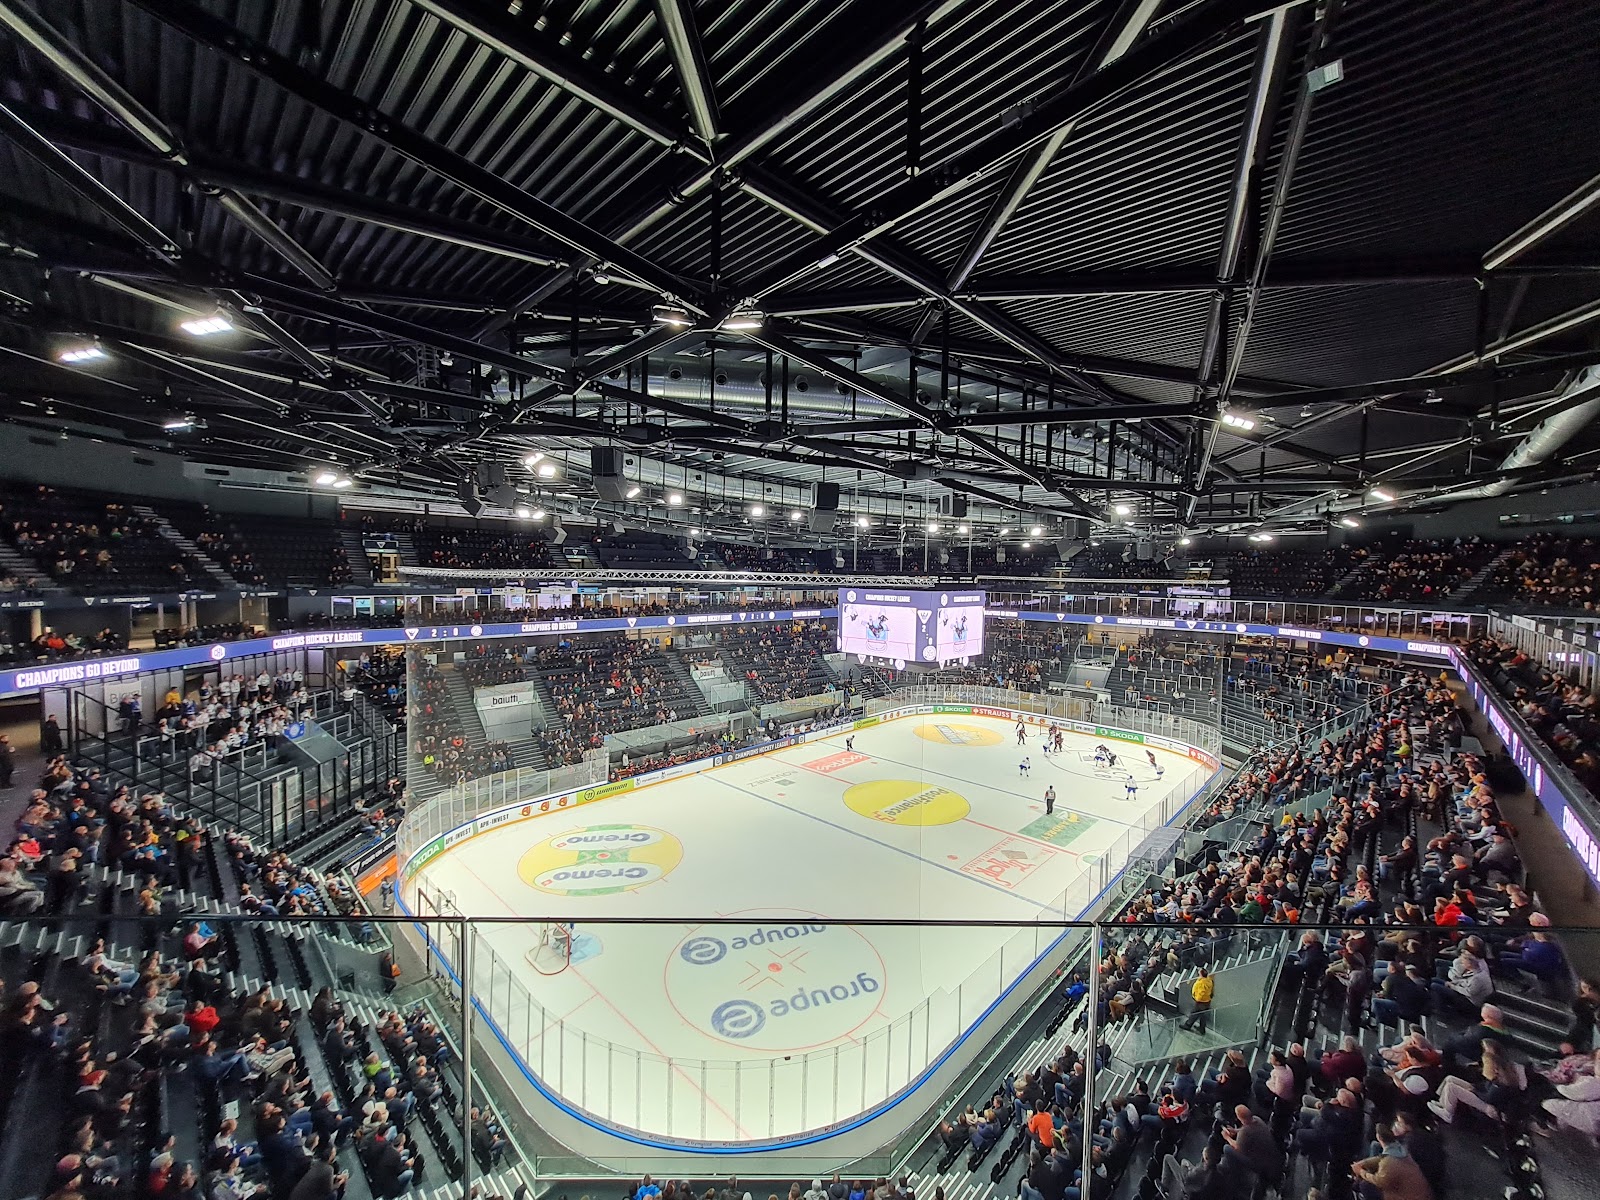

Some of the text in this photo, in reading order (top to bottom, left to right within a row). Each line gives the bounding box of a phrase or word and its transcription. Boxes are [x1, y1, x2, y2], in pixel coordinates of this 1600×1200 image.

[272, 635, 305, 650] CHAMPIONS
[334, 632, 363, 643] LEAGUE
[431, 629, 437, 638] 2
[16, 658, 140, 688] CHAMPIONS GO BEYOND
[978, 708, 1010, 718] STRAUSS
[735, 740, 788, 760] CHAMPIONS HOCKEY LEAGUE
[886, 788, 950, 817] PostFinance
[566, 832, 650, 844] Cremo
[553, 867, 648, 881] Cremo
[770, 972, 878, 1017] groupe
